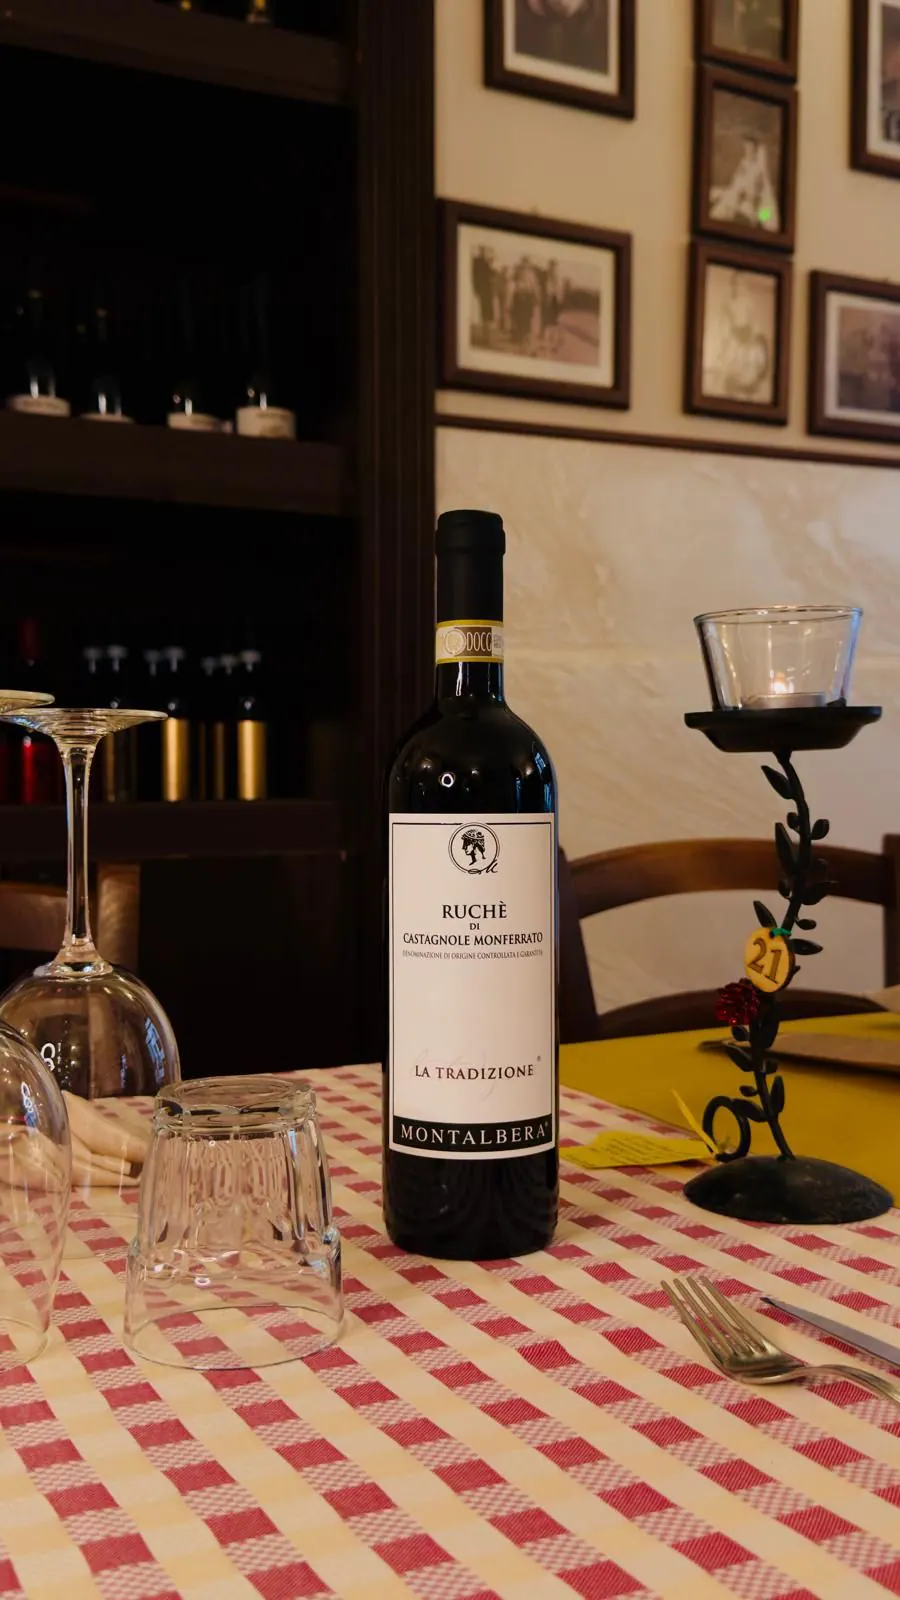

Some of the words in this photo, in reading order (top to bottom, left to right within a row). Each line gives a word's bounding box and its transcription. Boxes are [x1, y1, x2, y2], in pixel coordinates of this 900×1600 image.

[442, 901, 507, 918] RUCHÈ
[469, 922, 480, 930] DI
[403, 933, 470, 945] CASTAGNOLE
[474, 932, 543, 945] MONFERRATO
[451, 952, 476, 960] ORIGINE
[747, 937, 782, 984] 21
[415, 1065, 430, 1078] LA
[435, 1064, 534, 1080] TRADIZIONE
[401, 1123, 545, 1145] MONTALBERA
